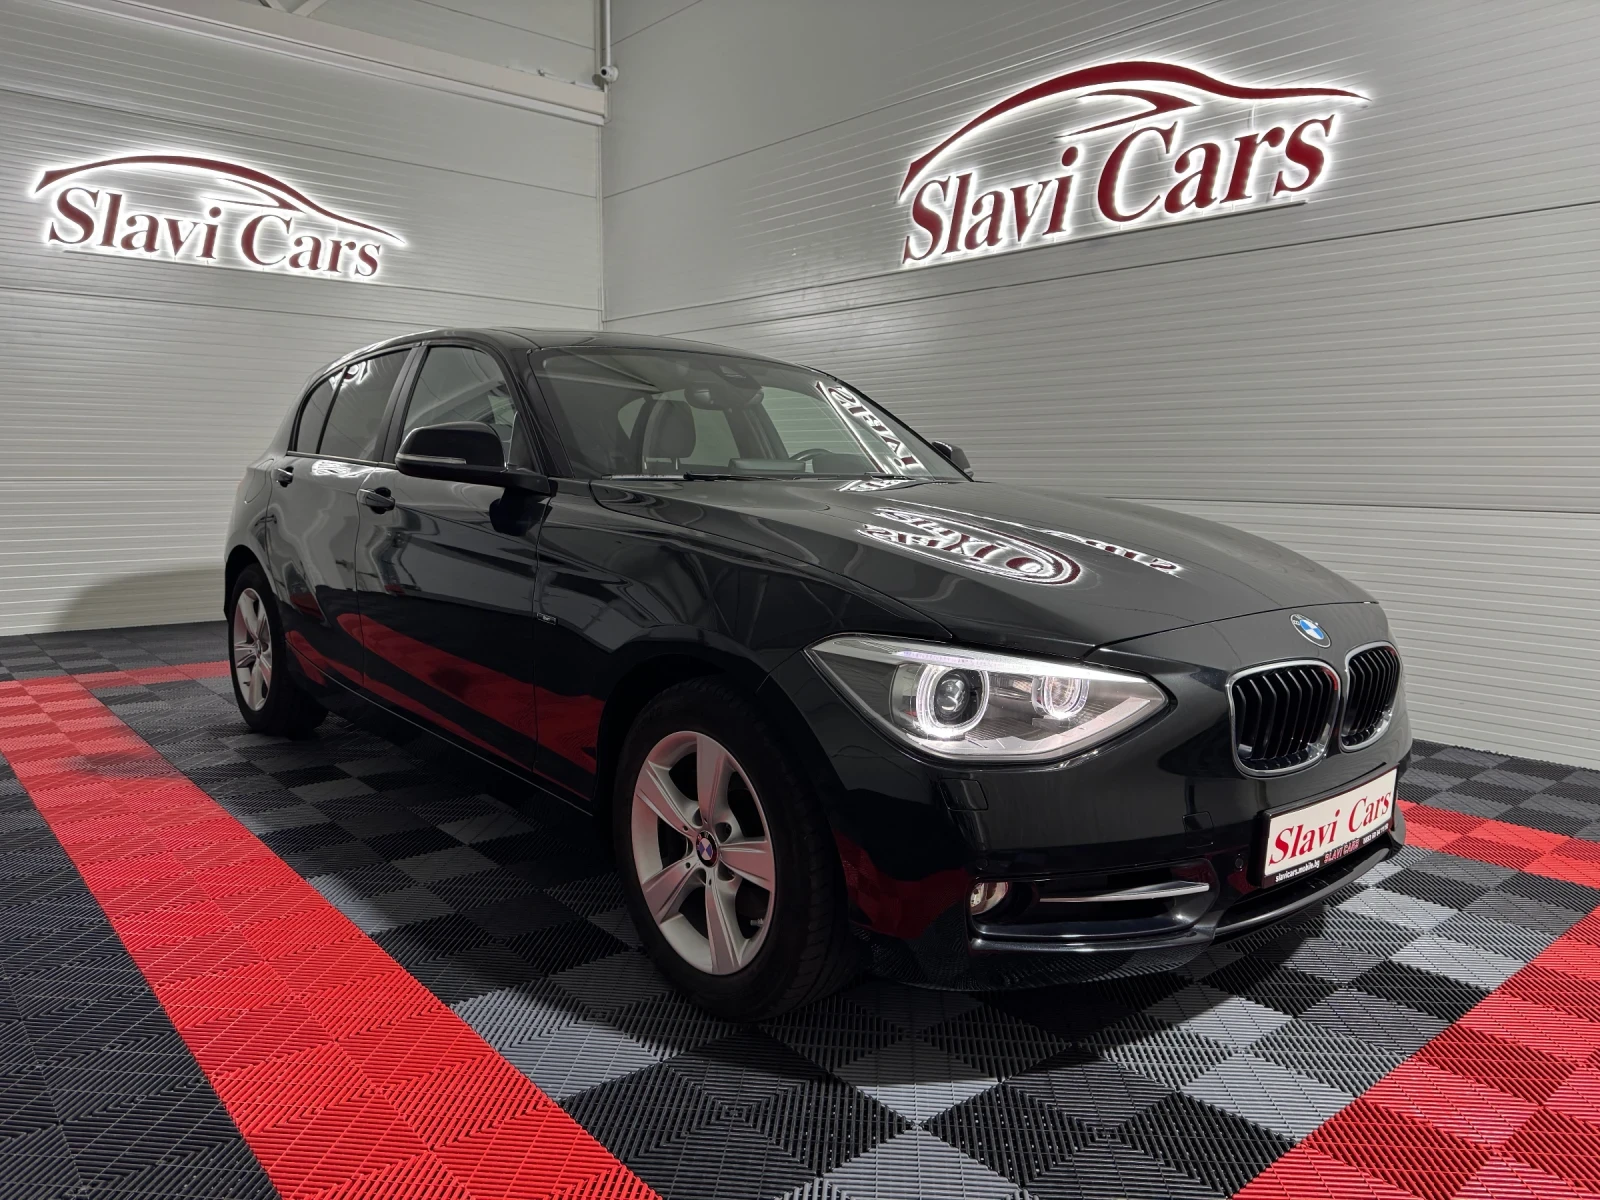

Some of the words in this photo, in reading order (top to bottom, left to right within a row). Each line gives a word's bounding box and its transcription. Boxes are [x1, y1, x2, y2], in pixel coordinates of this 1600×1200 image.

[902, 146, 1079, 264] Slavi
[1098, 114, 1335, 222] Cars
[49, 187, 221, 259] Slavi
[240, 215, 382, 277] Cars
[1269, 809, 1341, 866] Slavi
[1348, 792, 1391, 833] Cars
[1275, 860, 1320, 882] slavicars.mobile.bg
[1323, 846, 1343, 864] SLAVI
[1343, 838, 1360, 856] CARS
